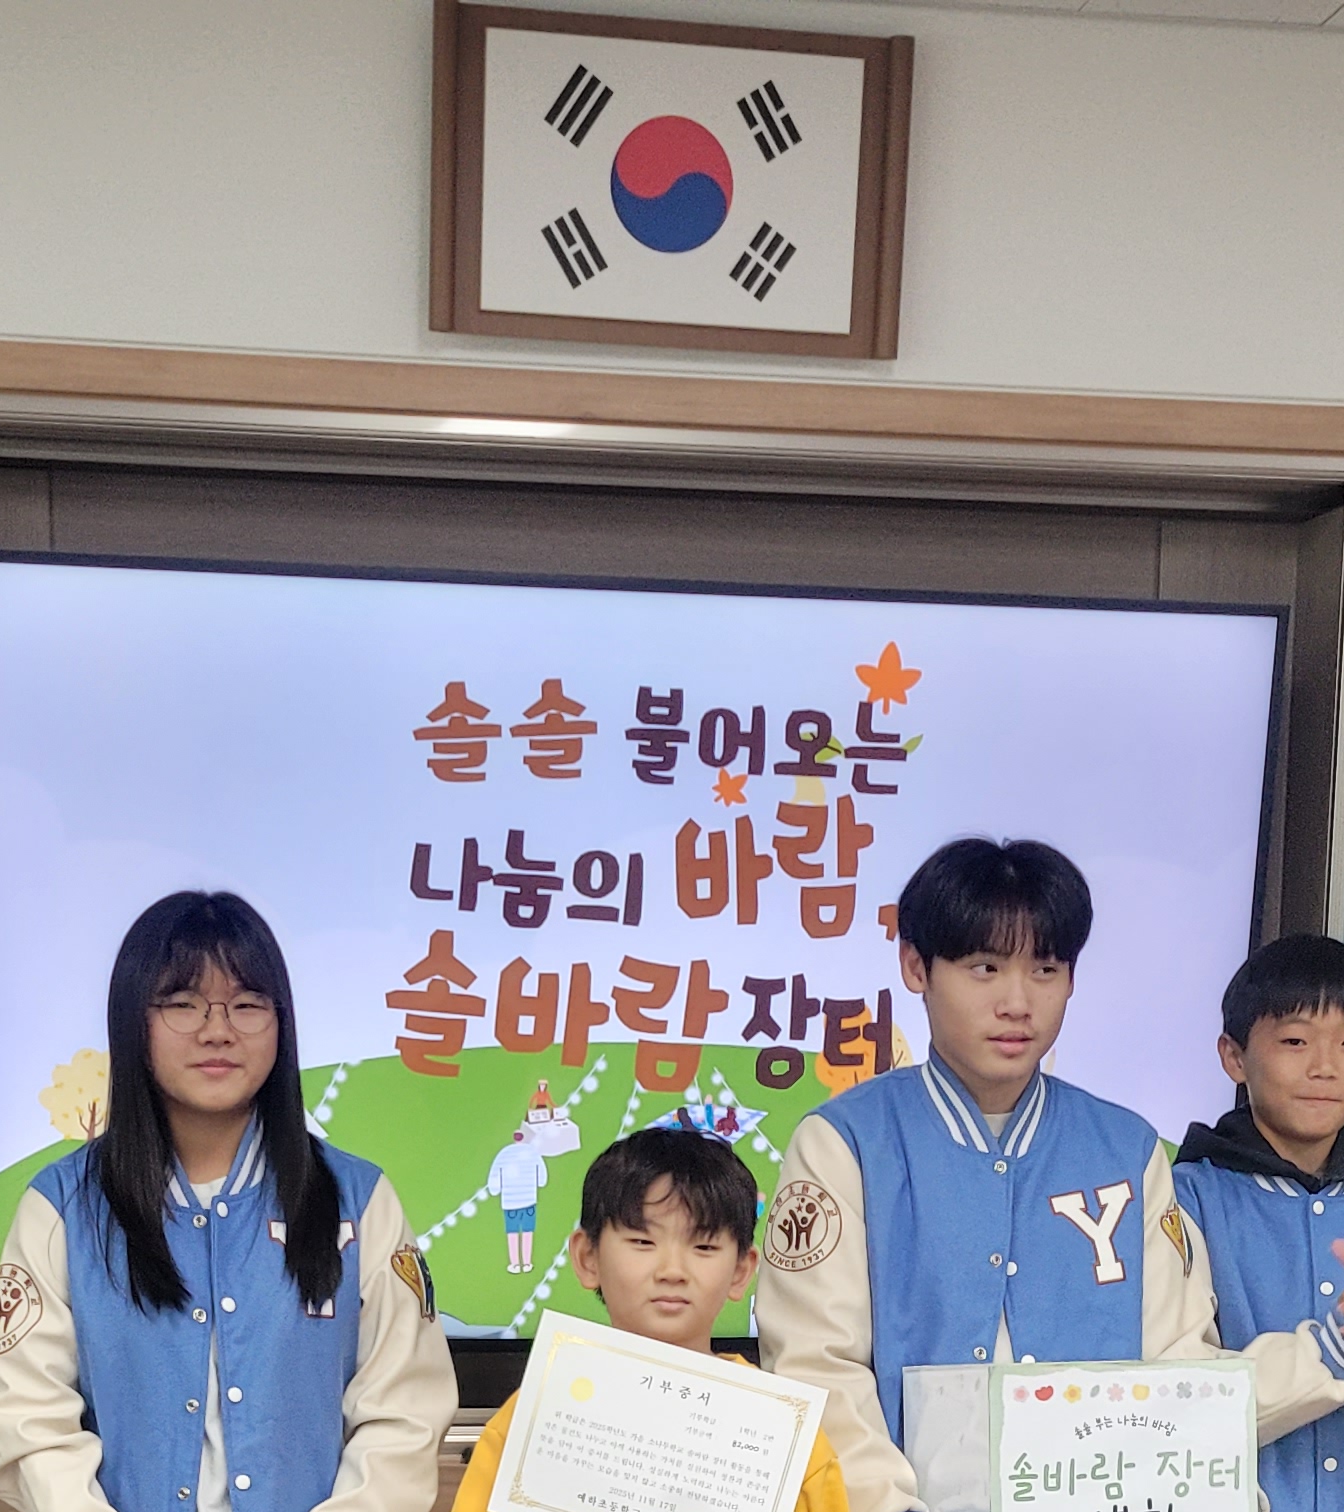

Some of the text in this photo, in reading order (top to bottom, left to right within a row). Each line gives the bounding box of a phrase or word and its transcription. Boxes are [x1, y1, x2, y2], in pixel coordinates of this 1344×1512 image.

[413, 678, 908, 795] 솔솔 불어오는
[409, 828, 644, 929] 나눔의
[385, 929, 894, 1093] 솔바람 장터
[769, 1252, 796, 1268] SINCE
[1050, 1180, 1132, 1286] Y
[640, 1375, 711, 1406] 기부증서
[1095, 1416, 1113, 1430] 부는
[1117, 1413, 1149, 1429] 나눔의
[1152, 1419, 1177, 1437] 바람
[1008, 1449, 1241, 1502] 솔바람 장터
